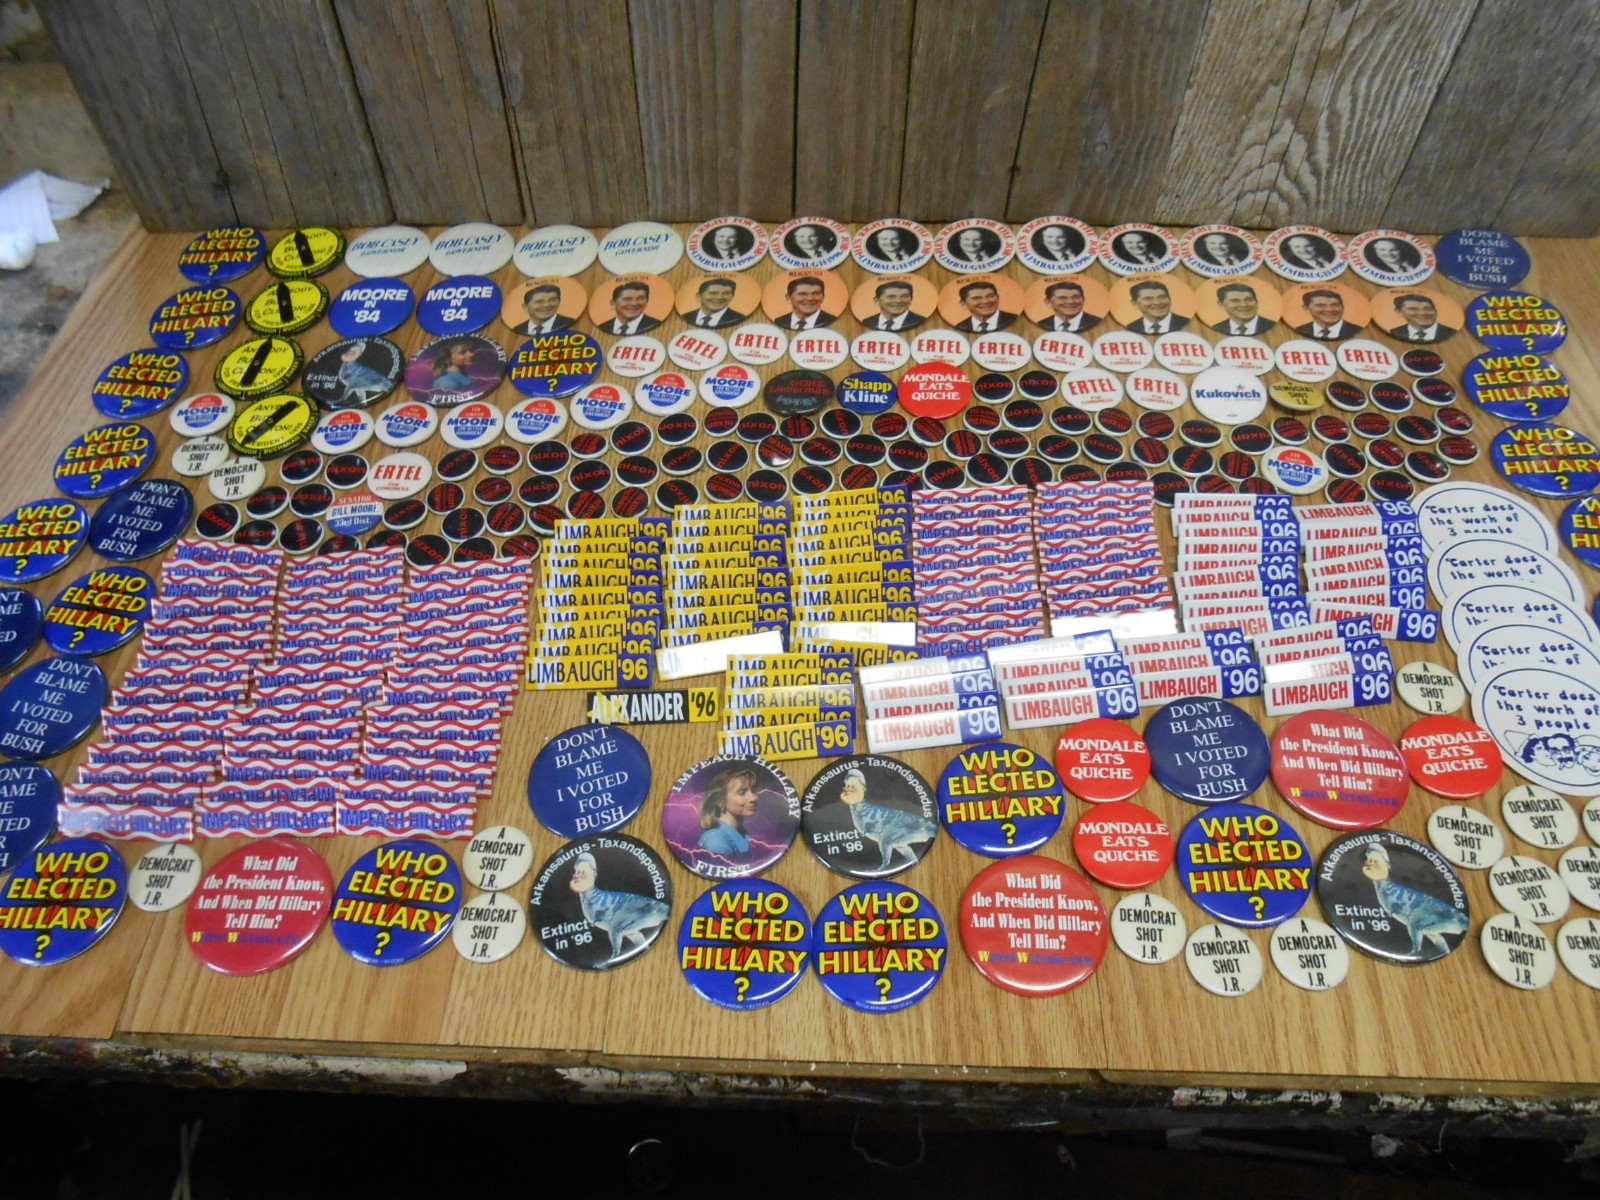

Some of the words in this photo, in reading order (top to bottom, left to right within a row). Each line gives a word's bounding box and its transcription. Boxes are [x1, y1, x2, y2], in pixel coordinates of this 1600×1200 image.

[354, 239, 380, 250] BOB
[382, 237, 423, 247] CASEY
[603, 239, 631, 250] BOB
[634, 234, 673, 247] CASEY
[177, 288, 228, 304] WHO
[426, 287, 493, 301] MOORE
[451, 298, 462, 306] IN
[160, 303, 236, 318] ELECTED
[441, 309, 468, 321] '84
[151, 314, 235, 333] HILLARY
[184, 331, 194, 344] ?
[735, 333, 779, 349] ERTEL
[612, 346, 657, 362] ERTEL
[859, 340, 902, 355] ERTEL
[1101, 342, 1146, 355] ERTEL
[1344, 350, 1391, 365] ERTEL
[1478, 355, 1540, 368] WHO
[306, 374, 339, 382] Extinct
[705, 378, 754, 388] MOORE
[843, 378, 892, 392] Shapp
[904, 374, 970, 383] MONDALE
[1474, 369, 1561, 386] ELECTED
[919, 383, 954, 391] EATS
[1196, 390, 1260, 398] Kukovich
[1477, 385, 1569, 403] HILLARY
[844, 390, 888, 403] Kline
[912, 392, 959, 401] QUICHE
[177, 405, 229, 418] MOORE
[1525, 401, 1538, 416] ?
[317, 424, 368, 436] MOORE
[214, 464, 258, 477] DEMOCRAT
[374, 464, 422, 480] ERTEL
[571, 469, 610, 482] nixon
[620, 463, 655, 474] nixon
[1268, 459, 1322, 476] MOORE
[224, 475, 246, 485] SHOT
[747, 481, 785, 490] nixon
[142, 481, 182, 496] DON'T
[130, 491, 177, 509] BLAME
[1483, 504, 1514, 512] does
[133, 504, 155, 517] ME
[332, 507, 348, 516] BILL
[351, 504, 378, 514] MOORE
[1300, 505, 1374, 519] LIMBAUGH
[109, 514, 116, 524] I
[118, 516, 163, 533] VOTED
[112, 529, 140, 542] FOR
[100, 539, 137, 555] BUSH
[88, 571, 146, 592] WHO
[61, 587, 146, 612] ELECTED
[46, 606, 138, 634] HILLARY
[70, 632, 84, 648] ?
[528, 660, 614, 684] LIMBAUGH
[618, 657, 648, 680] '96
[1422, 664, 1428, 673] A
[1140, 674, 1218, 699] LIMBAUGH
[1403, 674, 1454, 688] DEMOCRAT
[1272, 680, 1349, 706] LIMBAUGH
[1421, 688, 1444, 699] SHOT
[1559, 690, 1595, 700] does
[591, 693, 684, 723] ALEXANDER
[691, 694, 715, 717] '96
[1013, 695, 1093, 720] LIMBAUGH
[1170, 702, 1222, 718] DON'T
[1497, 700, 1523, 711] the
[1534, 704, 1574, 715] work
[1170, 716, 1234, 733] BLAME
[1516, 715, 1526, 726] 3
[1535, 720, 1590, 732] people
[721, 728, 814, 755] LIMBAUGH
[817, 725, 848, 748] '96
[1058, 738, 1146, 753] MONDALE
[1194, 733, 1222, 747] ME
[1401, 732, 1491, 750] MONDALE
[1080, 754, 1124, 764] EATS
[1175, 753, 1183, 765] I
[1184, 746, 1247, 763] VOTED
[1427, 746, 1474, 759] EATS
[1070, 767, 1133, 779] QUICHE
[1198, 764, 1235, 779] FOR
[1422, 758, 1487, 775] QUICHE
[672, 754, 746, 792] IMPEACH
[753, 755, 800, 818] HILLARY
[1196, 779, 1247, 796] BUSH
[202, 812, 266, 830] IMPEACH
[271, 812, 328, 828] HILLARY
[341, 809, 404, 827] IMPEACH
[409, 811, 466, 830] HILLARY
[1199, 815, 1279, 837] WHO
[498, 827, 504, 839] A
[813, 830, 859, 844] Extinct
[470, 840, 525, 856] DEMOCRAT
[828, 845, 839, 854] in
[842, 841, 863, 851] '96
[1189, 840, 1302, 864] ELECTED
[376, 849, 447, 875] WHO
[480, 858, 507, 871] SHOT
[695, 860, 750, 877] FIRST
[348, 871, 455, 903] ELECTED
[1006, 873, 1037, 888] What
[1040, 874, 1061, 889] Did
[1188, 866, 1311, 894] HILLARY
[711, 891, 788, 914] WHO
[972, 892, 992, 907] the
[996, 892, 1054, 909] President
[1058, 894, 1098, 914] Know,
[1145, 895, 1150, 907] A
[1249, 897, 1265, 918] ?
[333, 899, 451, 933] HILLARY
[1119, 909, 1176, 925] DEMOCRAT
[691, 917, 804, 942] ELECTED
[971, 913, 994, 928] And
[998, 914, 1031, 928] When
[1034, 915, 1054, 929] Did
[1058, 916, 1102, 936] Hillary
[1008, 933, 1032, 948] Tell
[1036, 934, 1066, 950] Him?
[1136, 927, 1163, 942] SHOT
[375, 932, 390, 955] ?
[682, 947, 807, 974] HILLARY
[734, 978, 749, 1002] ?
